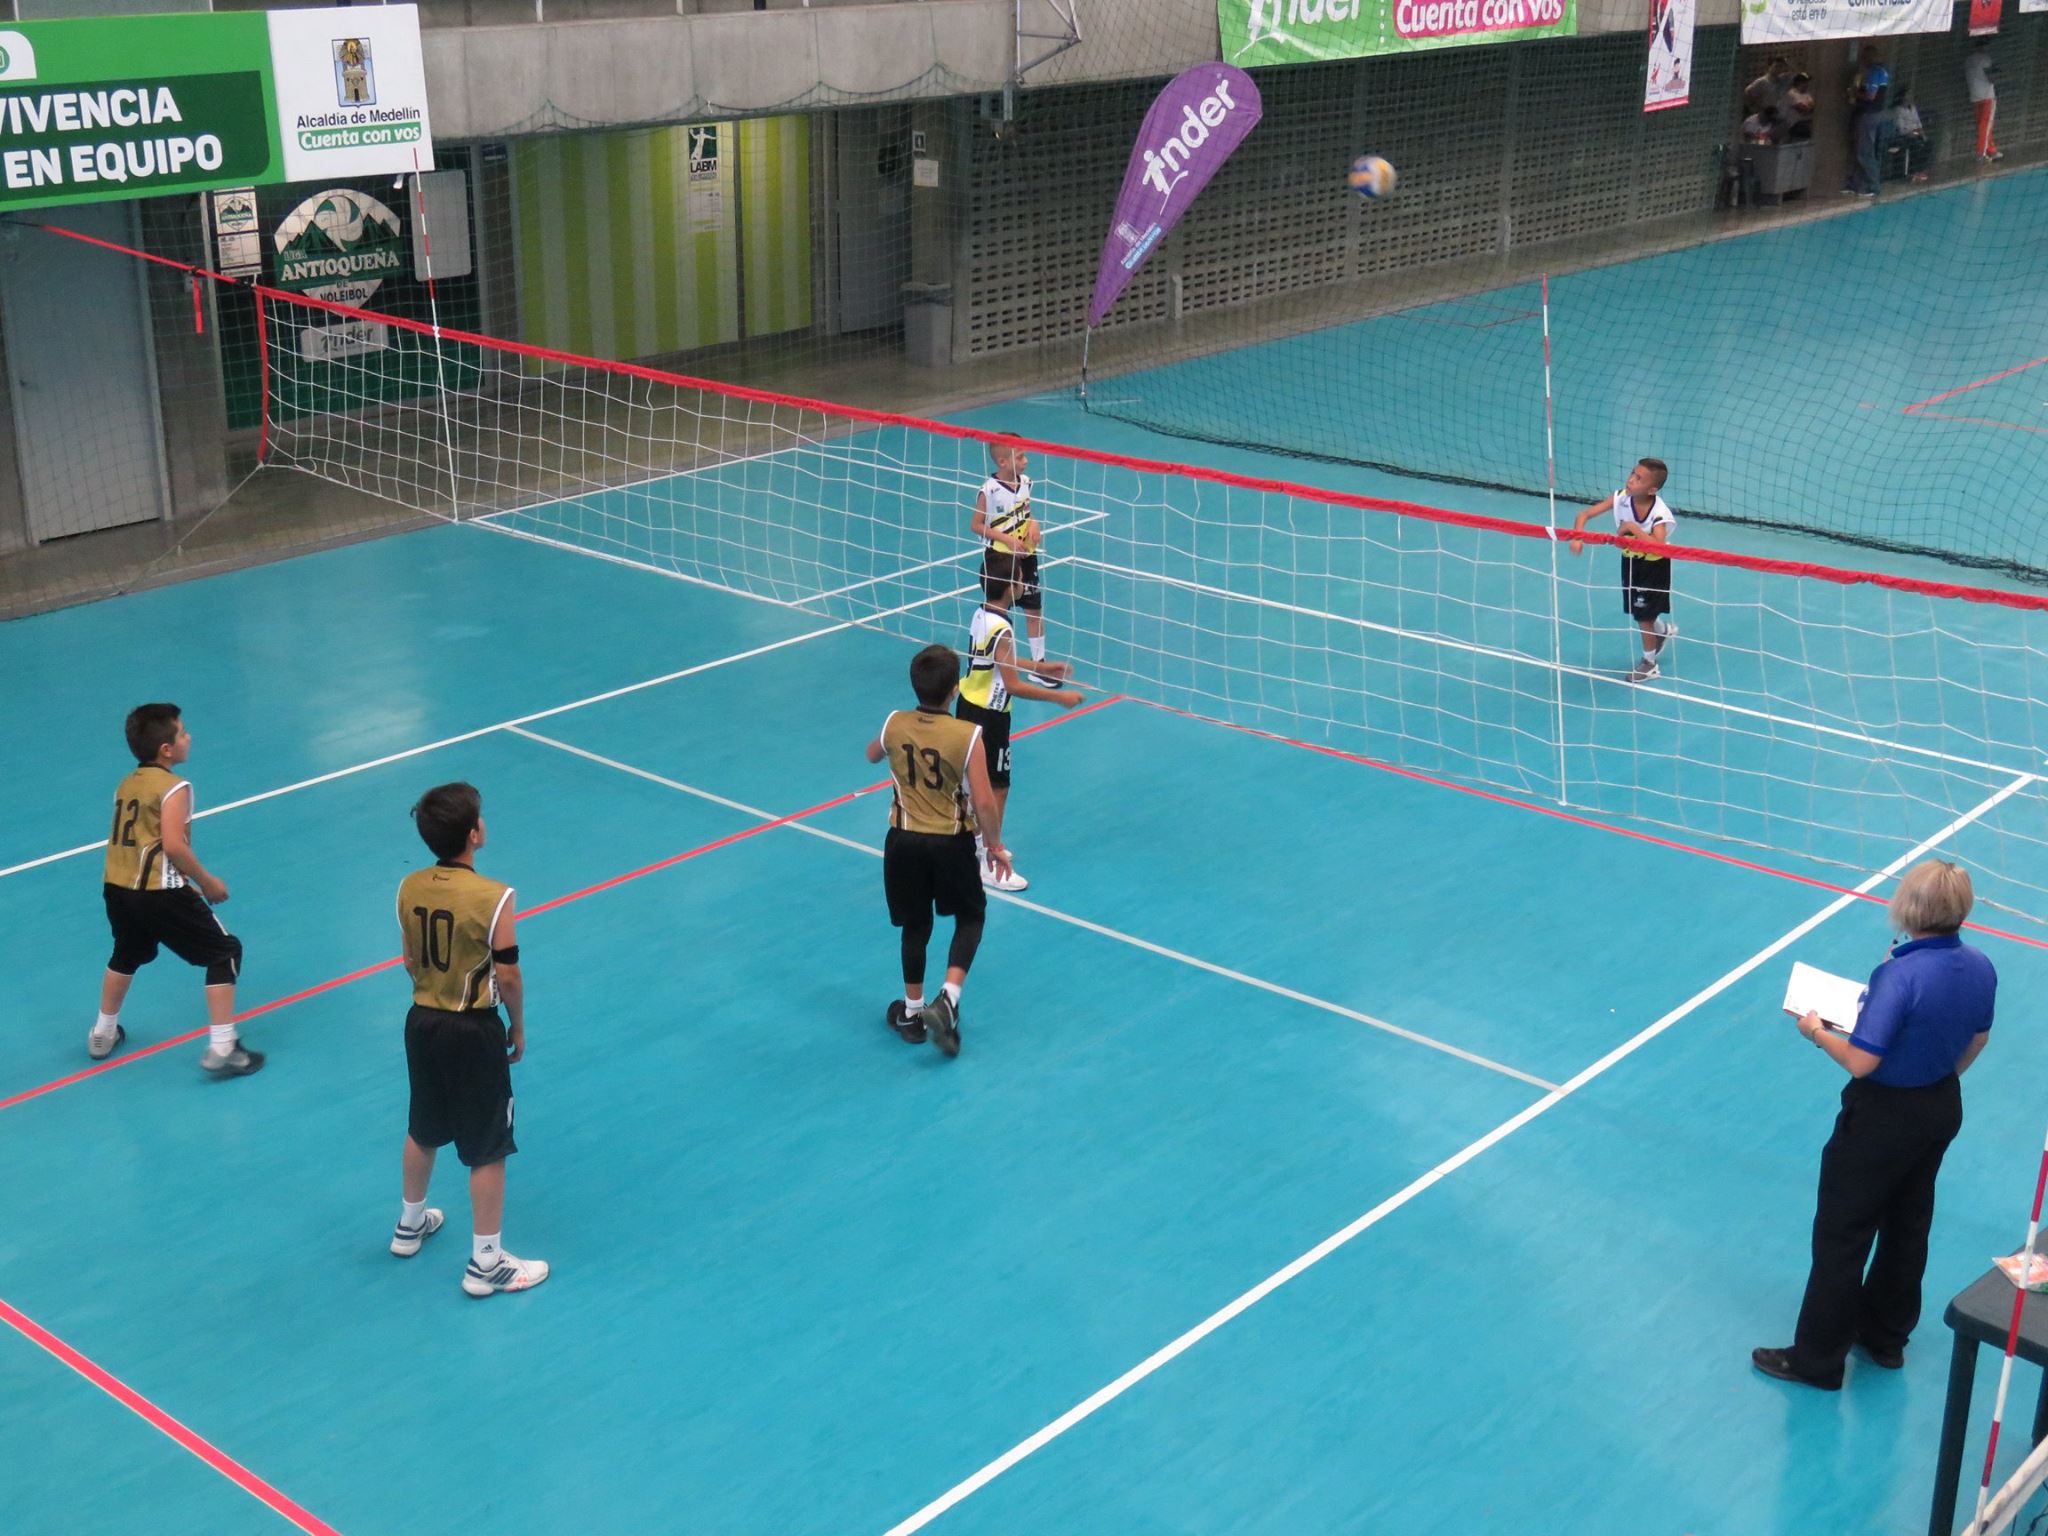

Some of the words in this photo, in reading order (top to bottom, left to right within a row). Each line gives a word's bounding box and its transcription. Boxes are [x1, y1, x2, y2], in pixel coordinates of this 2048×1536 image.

[1396, 0, 1477, 33] Cuenta
[1482, 0, 1525, 25] con
[0, 87, 182, 135] IVENCIA
[351, 111, 367, 124] de
[369, 106, 421, 122] Medellín
[301, 130, 360, 149] Cuenta
[362, 127, 392, 142] con
[394, 126, 420, 140] vos
[1142, 79, 1236, 195] inder
[4, 148, 63, 189] EN
[70, 134, 223, 183] EQUIPO
[690, 160, 717, 173] LABM
[281, 248, 400, 281] ANTIOQUEÑA
[320, 287, 368, 302] VOLEIBOL
[902, 743, 943, 790] 13
[997, 747, 1011, 772] 13
[112, 798, 139, 847] 12
[413, 906, 454, 972] 10
